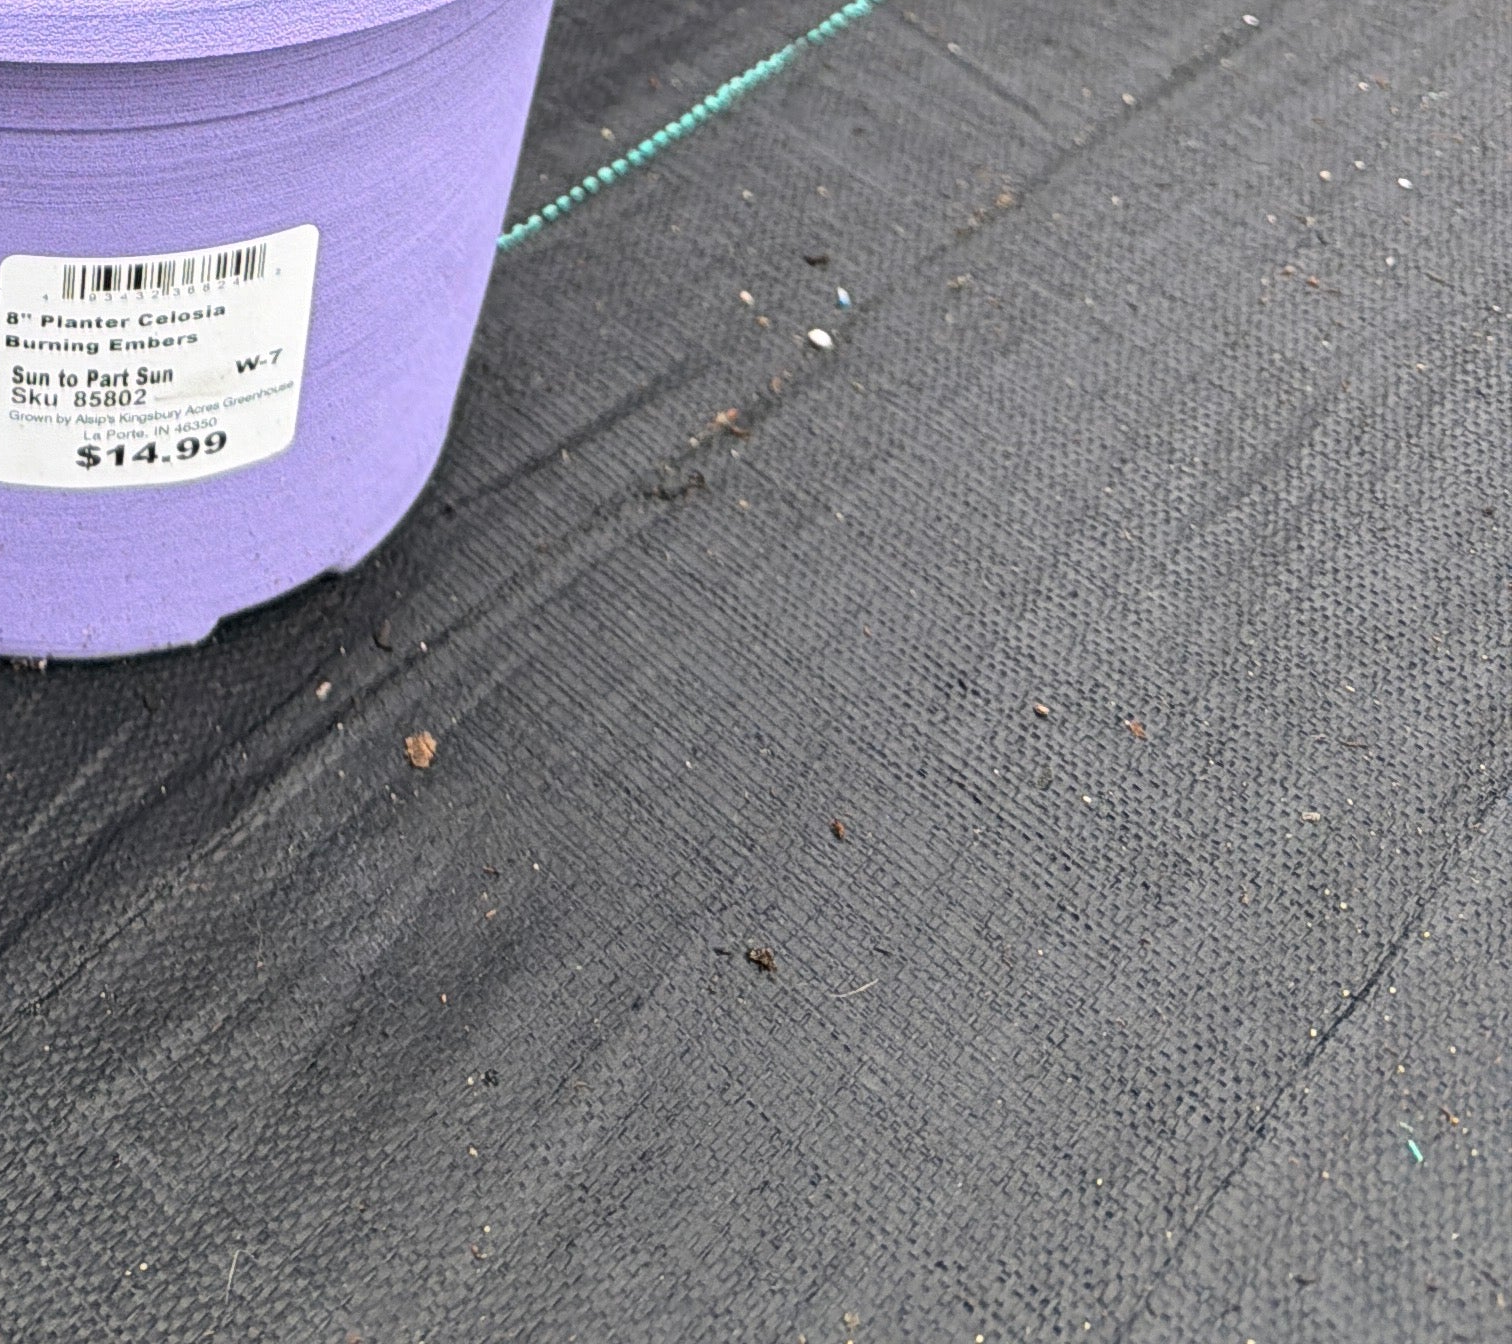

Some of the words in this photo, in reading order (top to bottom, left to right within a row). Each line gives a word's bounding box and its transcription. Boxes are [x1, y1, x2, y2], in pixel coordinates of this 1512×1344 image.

[6, 311, 32, 325] 8"
[40, 314, 130, 329] Planter
[138, 304, 226, 327] Celosia
[5, 334, 99, 355] Burning
[109, 333, 198, 351] Embers
[235, 347, 283, 374] W-7
[11, 365, 50, 387] Sun
[58, 369, 78, 388] to
[86, 368, 129, 388] Part
[136, 366, 174, 386] Sun
[9, 409, 53, 423] Grown
[56, 412, 71, 426] by
[75, 413, 116, 426] Alsip's
[119, 409, 182, 425] Kingsbury
[185, 401, 220, 415] Acres
[223, 380, 294, 408] Greenhouse
[11, 387, 58, 407] Sku
[73, 388, 147, 407] 85802
[83, 429, 101, 441] La
[154, 424, 170, 436] IN
[174, 416, 218, 434] 46350
[75, 430, 227, 471] $14.99
